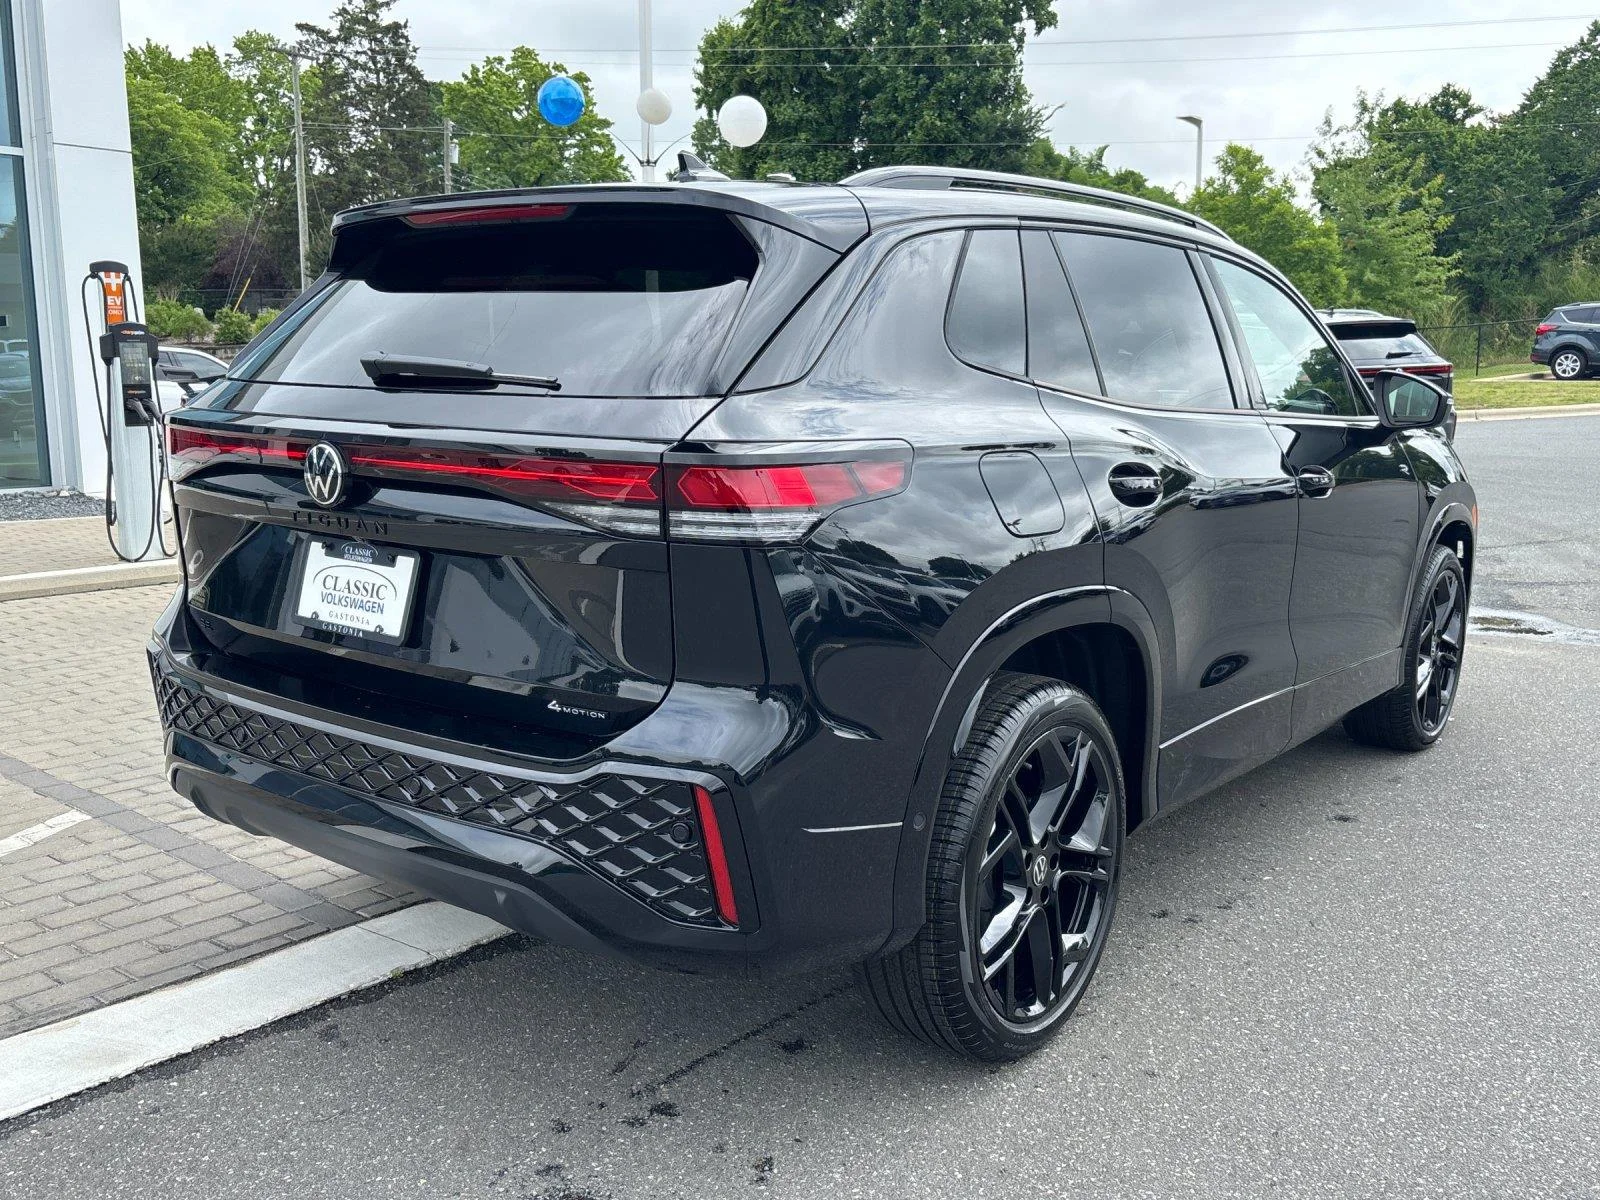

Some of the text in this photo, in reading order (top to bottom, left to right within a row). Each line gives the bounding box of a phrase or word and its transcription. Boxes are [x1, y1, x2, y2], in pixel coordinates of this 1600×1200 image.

[107, 296, 121, 305] EV
[292, 511, 388, 535] TIGUAN
[344, 554, 373, 564] VOLKSWAGEN
[345, 546, 374, 558] CLASSIC
[322, 574, 388, 601] CLASSIC
[321, 591, 385, 615] VOLKSWAGEN
[328, 610, 370, 626] GASTONIA
[322, 622, 363, 638] GASTONIA
[547, 700, 605, 719] 4MOTION
